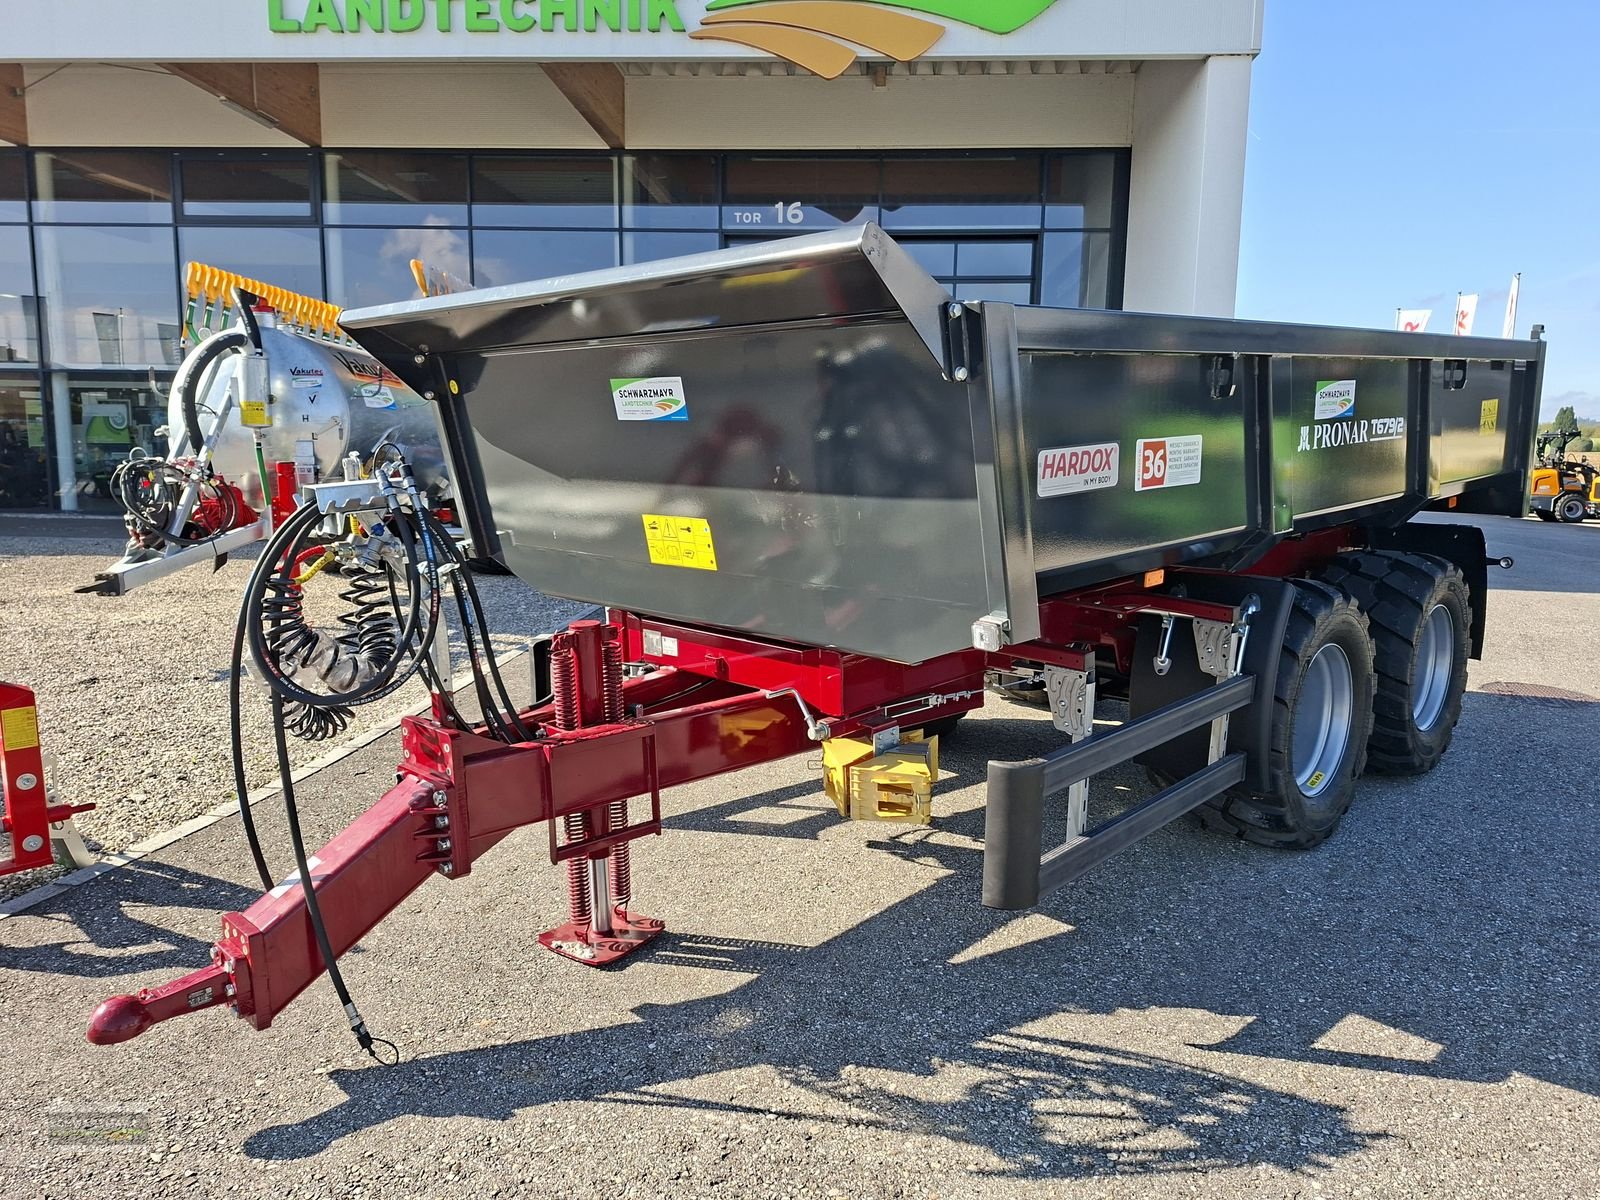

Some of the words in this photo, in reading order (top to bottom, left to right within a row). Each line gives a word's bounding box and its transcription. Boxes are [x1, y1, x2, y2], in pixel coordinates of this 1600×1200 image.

[267, 0, 687, 33] LANDTECHNIK
[734, 212, 762, 224] TOR
[774, 201, 804, 224] 16
[290, 366, 324, 376] Vakutec
[618, 388, 674, 399] SCHWARZMAYR
[1319, 389, 1351, 400] SCHWARZMAYR
[1312, 419, 1369, 450] PRONAR
[1370, 416, 1405, 437] T679/2
[1041, 447, 1114, 480] HARDOX
[1143, 449, 1165, 480] 36
[1083, 478, 1089, 486] IN
[1089, 477, 1098, 486] MY
[1098, 475, 1112, 484] BODY
